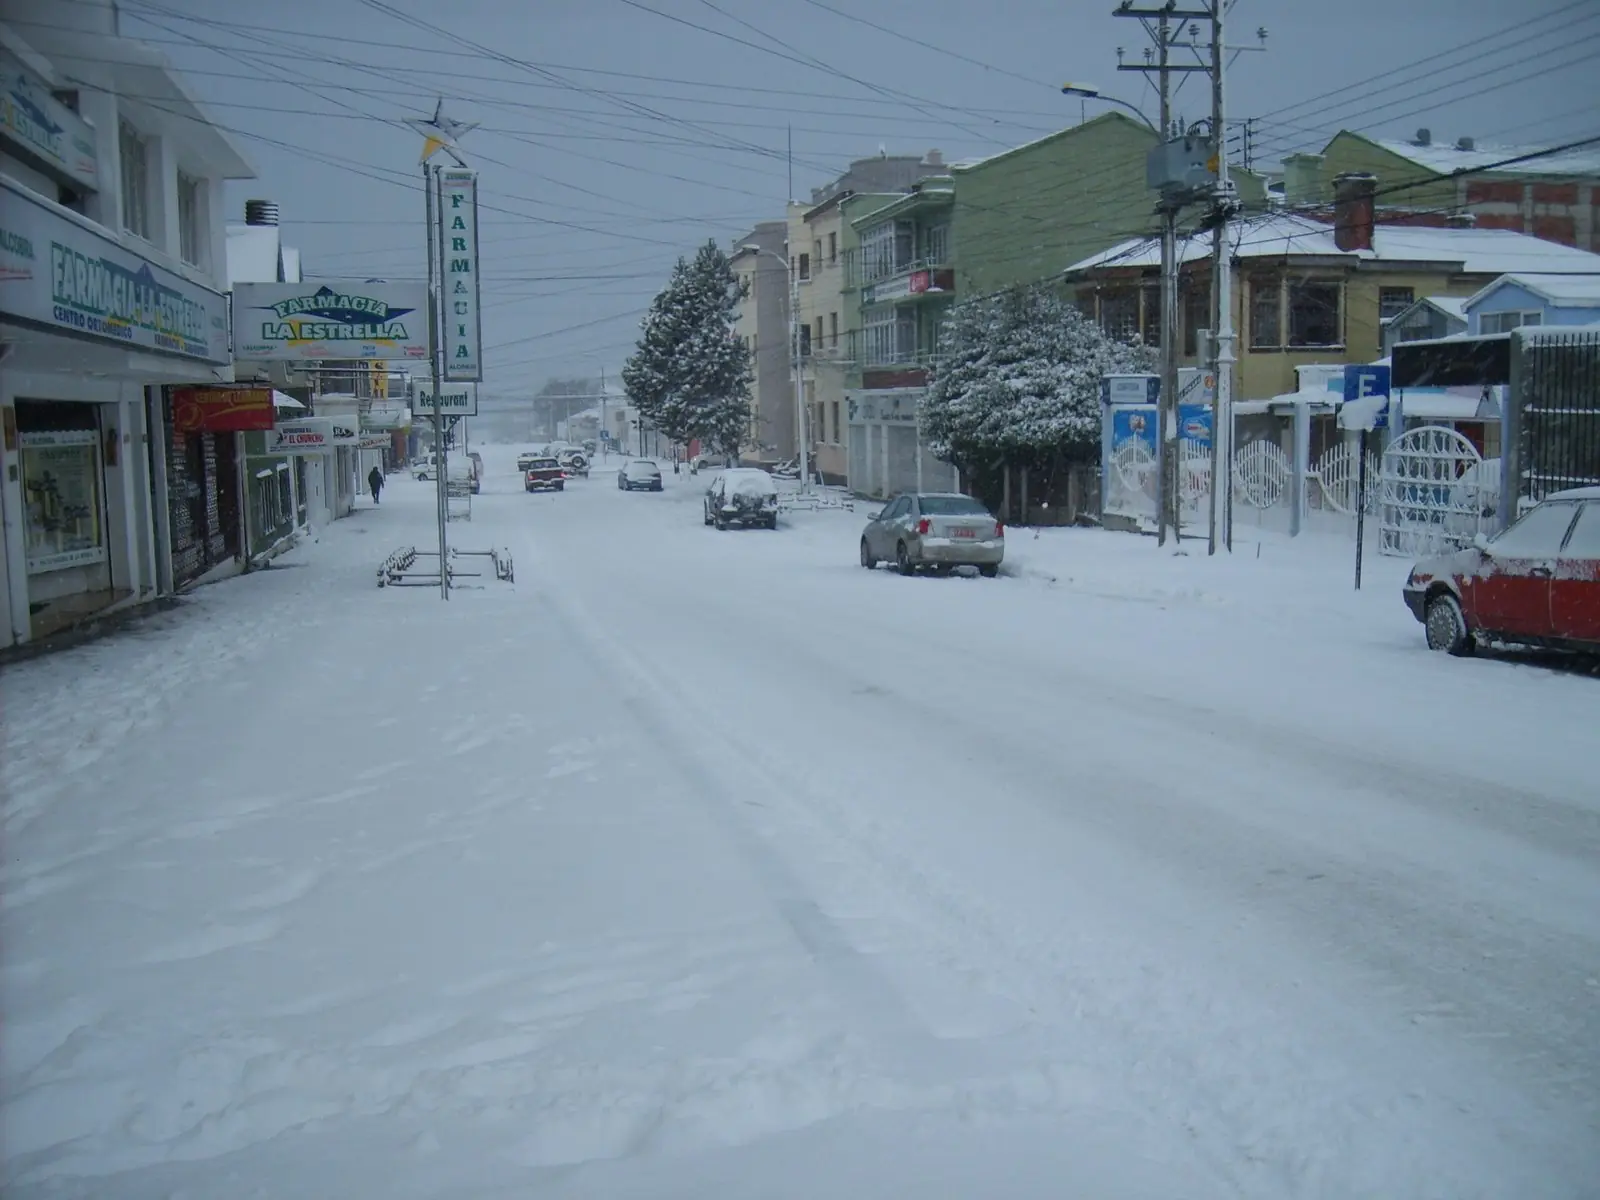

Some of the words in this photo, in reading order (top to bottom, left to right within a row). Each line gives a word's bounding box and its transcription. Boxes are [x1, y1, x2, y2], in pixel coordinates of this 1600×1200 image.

[51, 240, 137, 322] FARMACIA
[451, 193, 470, 359] FARMACIA
[272, 295, 389, 319] FARMACIA
[53, 305, 86, 328] CENTRO
[87, 315, 133, 339] ORTOMEDICO
[262, 322, 295, 340] LA
[300, 322, 409, 340] ESTRELLA
[420, 390, 468, 408] Resaurant
[1359, 374, 1376, 399] E
